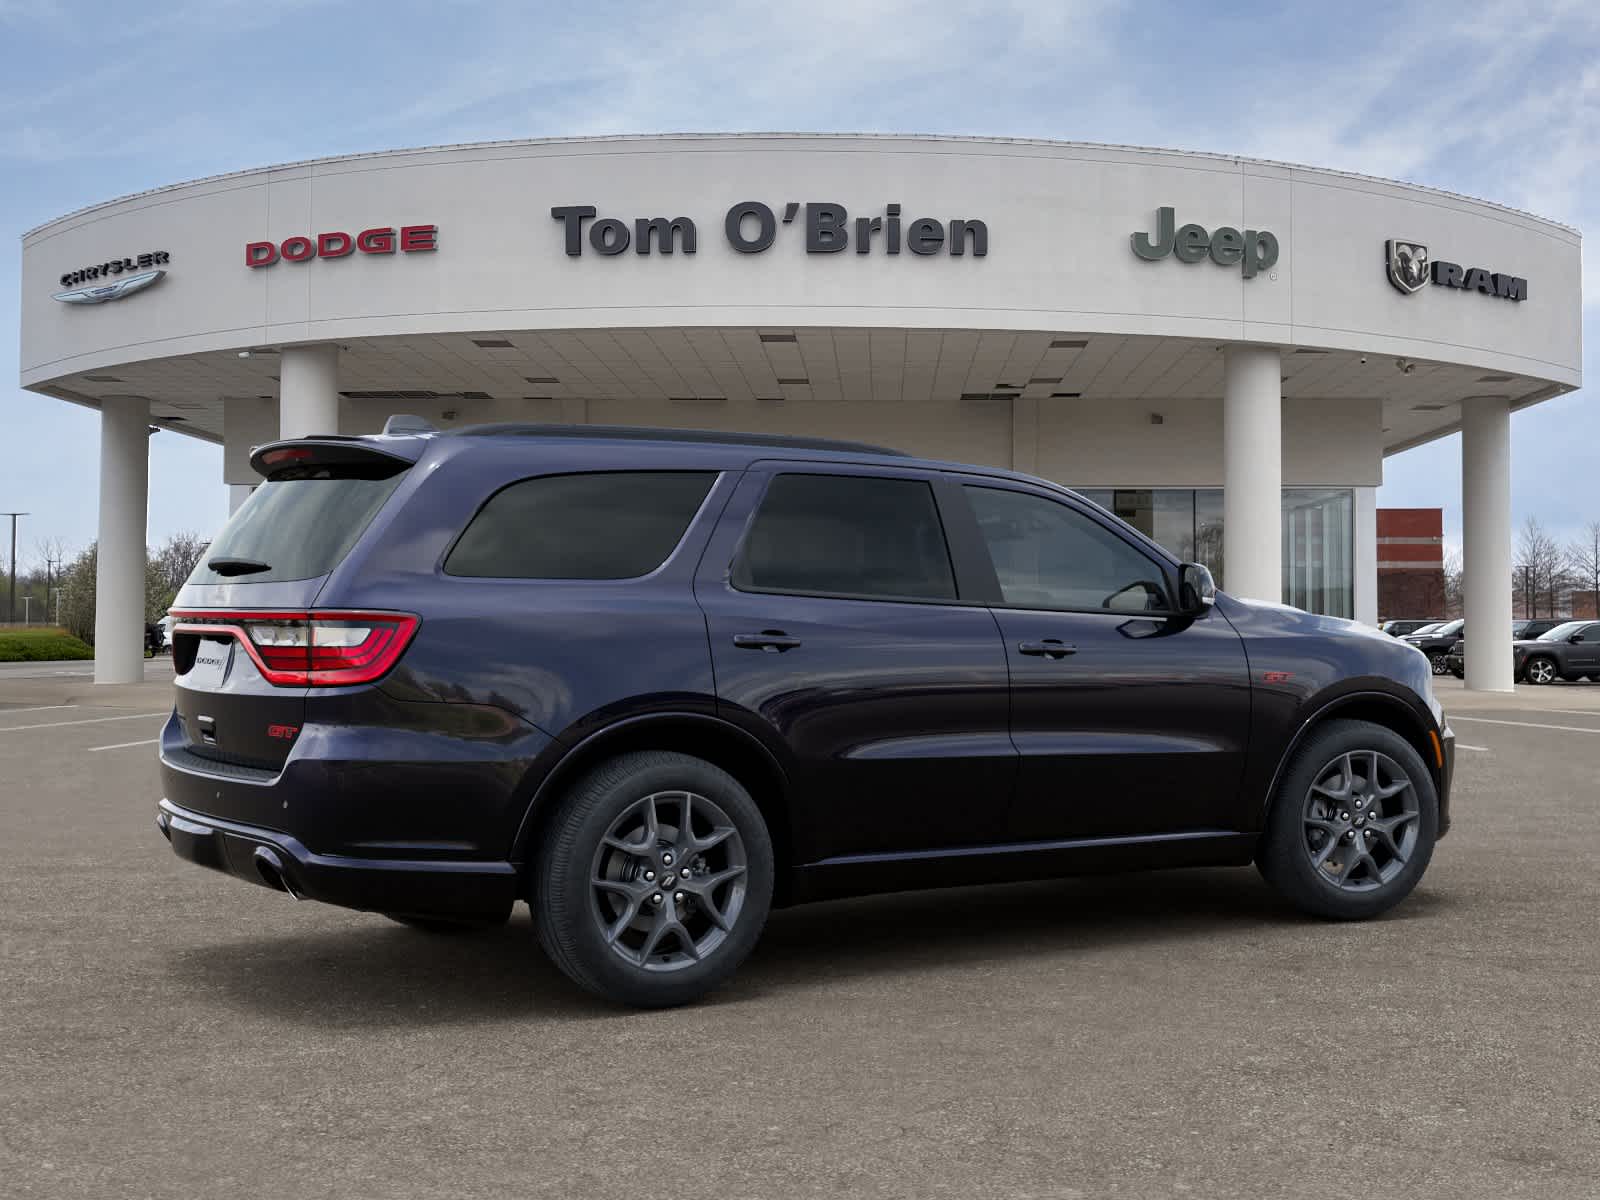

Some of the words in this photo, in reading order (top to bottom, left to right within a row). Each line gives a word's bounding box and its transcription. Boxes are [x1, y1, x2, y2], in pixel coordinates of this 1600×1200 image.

[245, 224, 437, 268] DODGE
[551, 205, 697, 256] Tom
[725, 201, 988, 256] O'Brien
[1130, 206, 1279, 279] Jeep
[60, 250, 170, 287] CHRYSLER
[1431, 260, 1528, 301] RAM
[267, 724, 298, 739] GT
